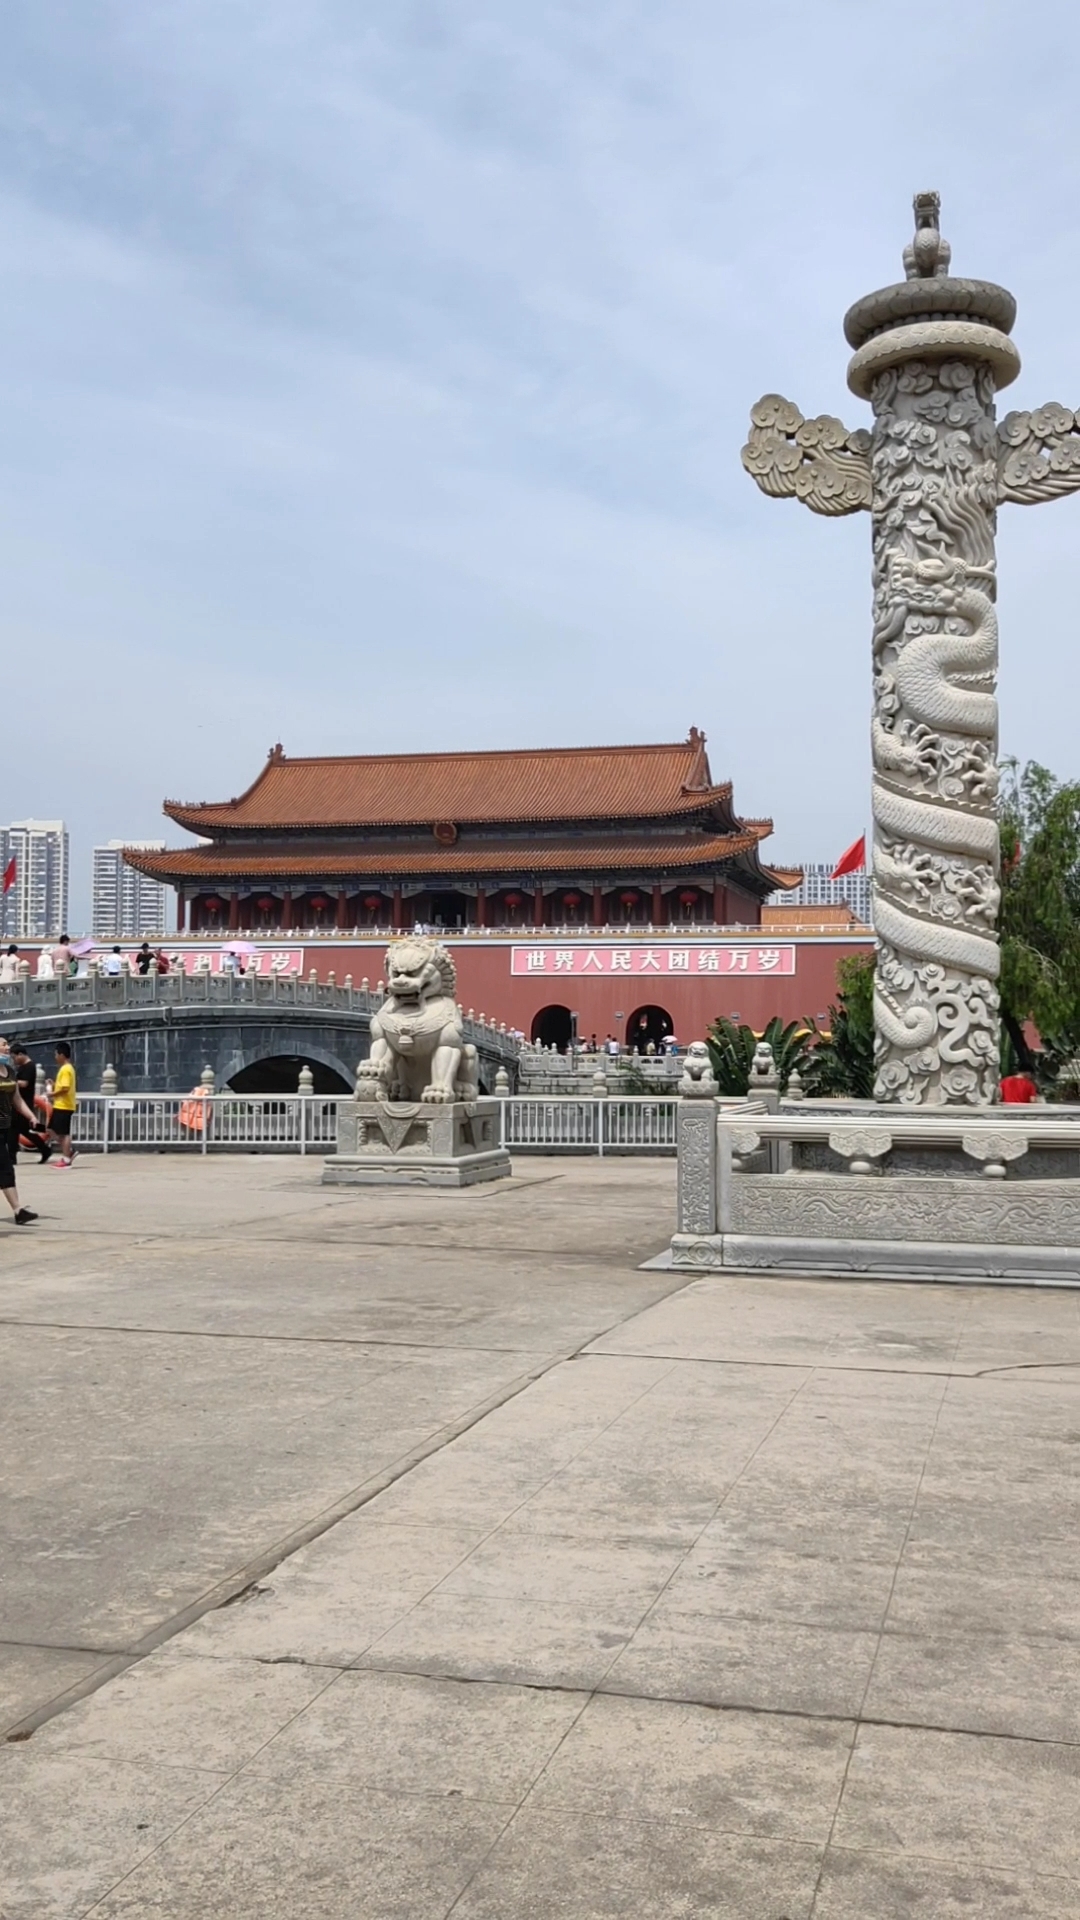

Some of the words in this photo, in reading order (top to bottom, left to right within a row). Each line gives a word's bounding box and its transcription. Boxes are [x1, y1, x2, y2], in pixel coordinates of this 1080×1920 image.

[526, 949, 782, 972] 世界人民大团结万岁
